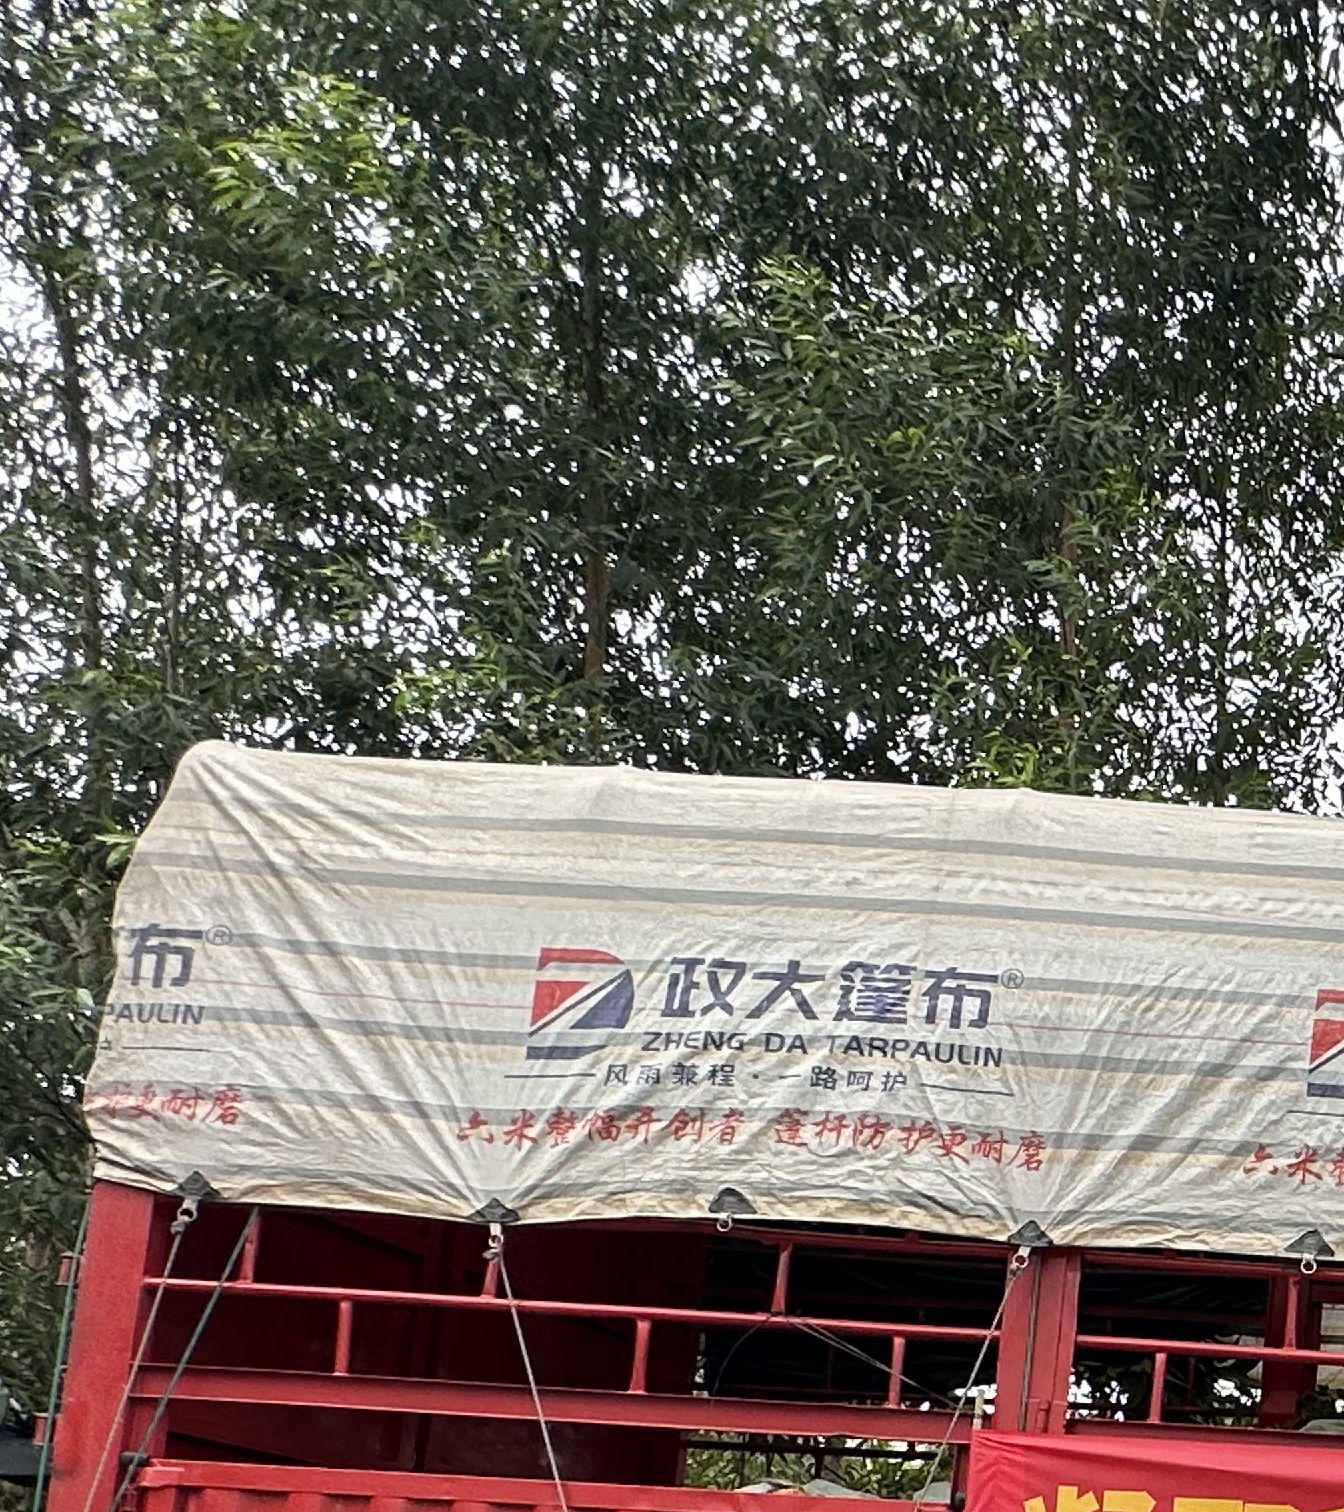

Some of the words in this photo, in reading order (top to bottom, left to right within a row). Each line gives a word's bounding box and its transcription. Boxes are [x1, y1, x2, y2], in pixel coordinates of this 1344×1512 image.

[641, 1031, 746, 1053] ZHENG
[764, 1032, 809, 1056] DA
[828, 1035, 1004, 1068] TARPAULIN
